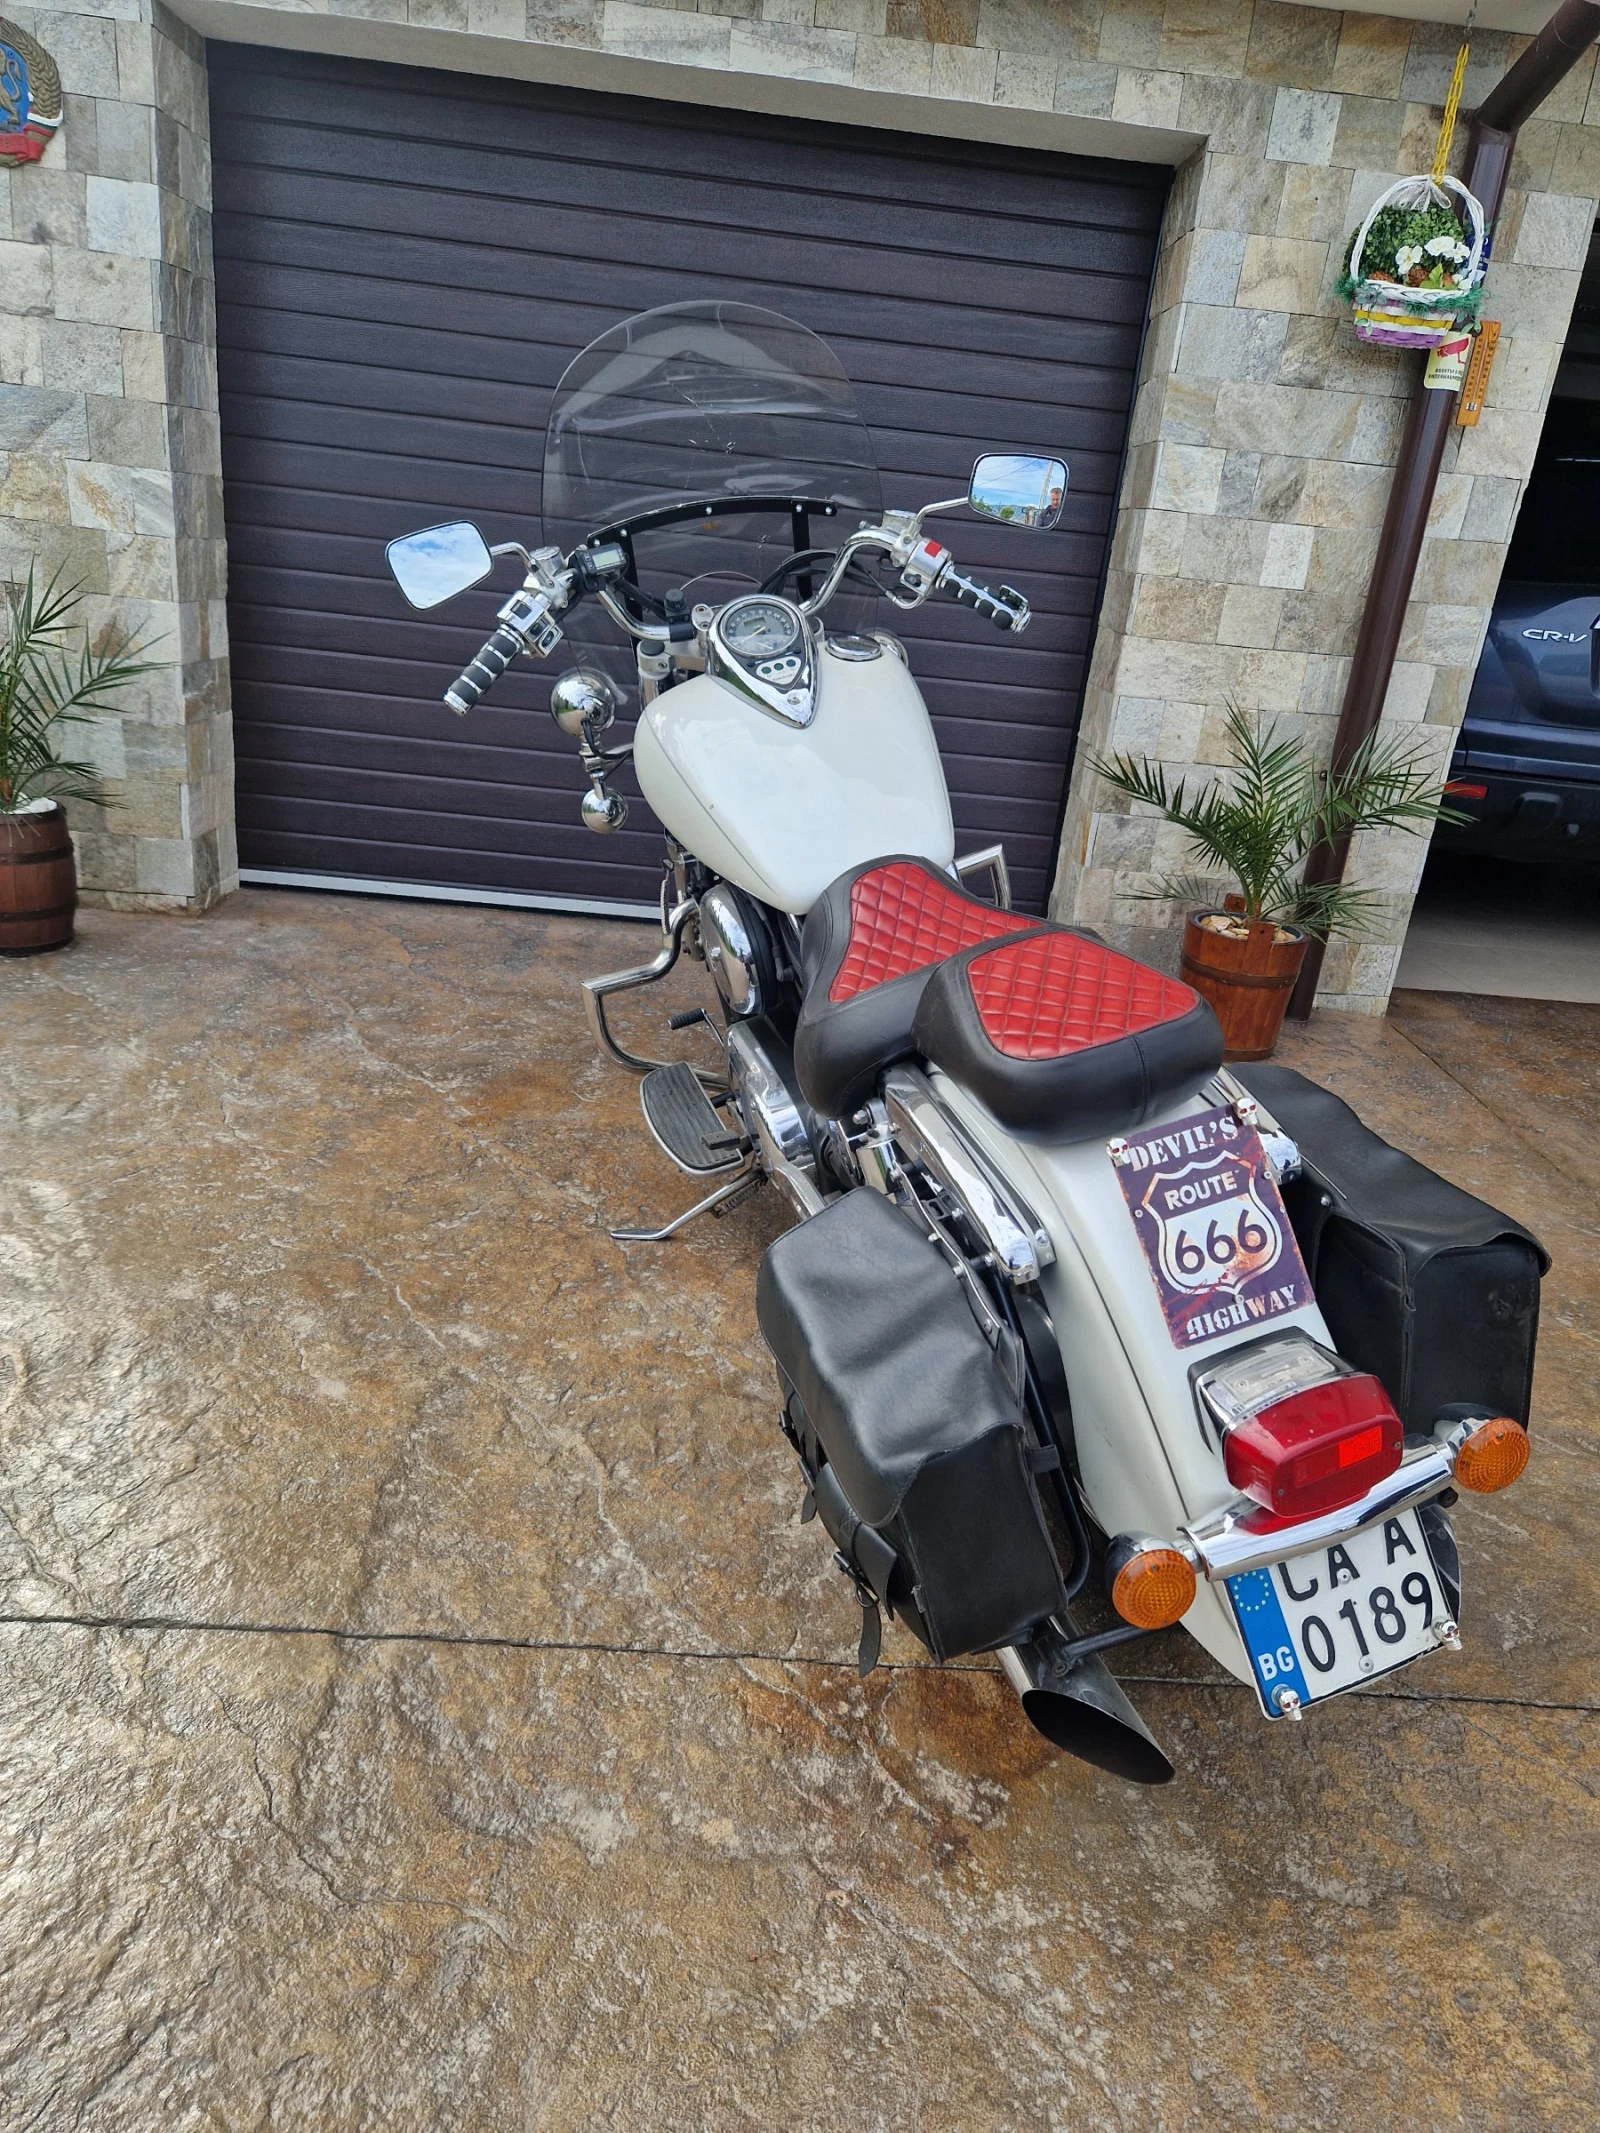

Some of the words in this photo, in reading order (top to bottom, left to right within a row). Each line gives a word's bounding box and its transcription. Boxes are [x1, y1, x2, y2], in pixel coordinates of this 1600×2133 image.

[1522, 628, 1588, 643] CR-V
[1128, 1116, 1239, 1172] DEVIL'S
[1164, 1171, 1238, 1211] ROUTE
[1174, 1208, 1268, 1275] 666
[1186, 1284, 1297, 1341] HIGHWAY
[1278, 1543, 1361, 1602] CA
[1383, 1516, 1417, 1566] A
[1301, 1571, 1433, 1673] 0189
[1257, 1645, 1295, 1682] BG
